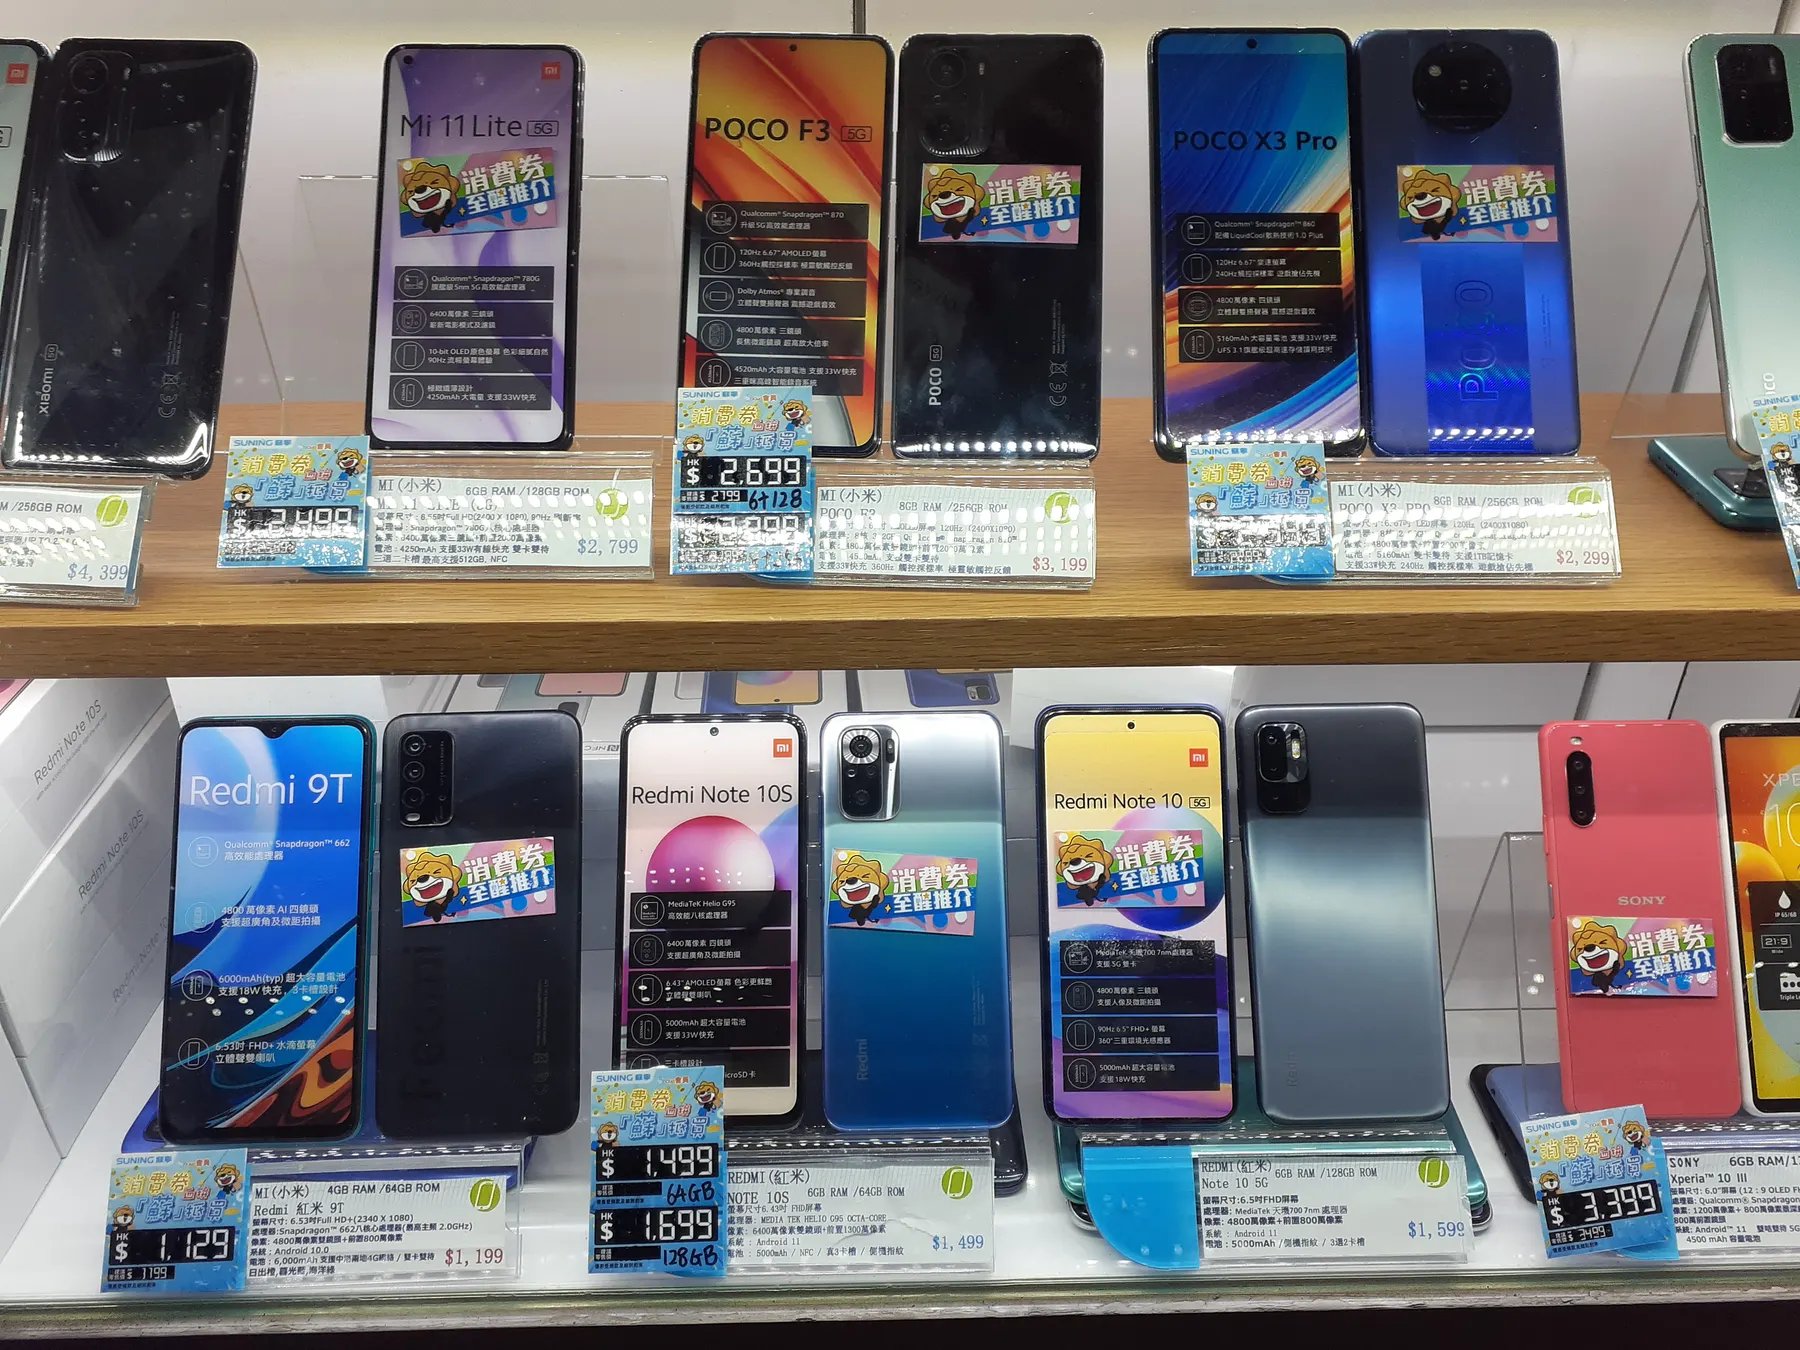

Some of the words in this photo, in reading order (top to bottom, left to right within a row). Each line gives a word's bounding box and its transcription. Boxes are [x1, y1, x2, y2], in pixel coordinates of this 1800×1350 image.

[401, 114, 431, 136] Mi
[441, 115, 464, 136] 11
[473, 114, 522, 136] Lite
[533, 123, 553, 134] 5G
[705, 117, 789, 141] POCO
[800, 119, 830, 141] F3
[847, 128, 866, 139] 5G
[1174, 131, 1247, 150] POCO
[1255, 131, 1287, 150] X3
[1296, 131, 1337, 150] Pro
[461, 153, 545, 194] 消費券
[988, 171, 1071, 205] 消費券
[1463, 171, 1547, 205] 消費券
[465, 179, 550, 215] 至醒推介
[990, 196, 1075, 225] 至醒推介
[1467, 196, 1552, 226] 至醒推介
[738, 288, 757, 296] Dolby
[1217, 335, 1249, 343] 5160mAh
[735, 366, 767, 374] 4520mAh
[929, 367, 942, 406] POCO
[1753, 396, 1789, 407] SUNING
[692, 405, 759, 425] 消費券
[234, 439, 273, 447] SUNING
[241, 453, 314, 475] 消費券
[720, 458, 801, 485] 2,699
[1202, 463, 1271, 483] 消費券
[465, 487, 487, 496] 6GB
[491, 487, 516, 496] RAM
[748, 489, 802, 510] 6+128
[56, 504, 82, 513] ROM
[900, 502, 917, 511] 8GB
[923, 503, 941, 512] RAM
[1458, 497, 1476, 506] RAM
[513, 544, 549, 554] 雙卡雙待
[578, 539, 639, 555] $2,799
[1414, 551, 1450, 560] 雙卡雙待
[1557, 551, 1610, 566] $2,299
[68, 562, 128, 581] $4,399
[1033, 557, 1087, 572] $3,199
[34, 743, 65, 785] Redmi
[63, 720, 86, 750] Note
[190, 774, 295, 806] Redmi
[308, 773, 352, 804] 9T
[633, 786, 694, 804] Redmi
[701, 786, 750, 803] Note
[757, 785, 793, 803] 10S
[1054, 793, 1108, 810] Redmi
[1114, 793, 1156, 809] Note
[1162, 793, 1183, 809] 10
[224, 851, 284, 861] 高效能處理器
[1115, 835, 1195, 871] 消費券
[464, 843, 545, 884] 消費券
[892, 864, 969, 893] 消費券
[1119, 860, 1199, 891] 至醒推介
[467, 869, 551, 904] 至醒推介
[893, 888, 972, 913] 至醒推介
[1617, 896, 1666, 905] SONY
[290, 905, 319, 914] 四鏡頭
[1627, 924, 1706, 958] 消費券
[1632, 949, 1712, 979] 至醒推介
[286, 973, 345, 983] 超大容量電池
[700, 1019, 747, 1027] 超大容量電池
[277, 1040, 316, 1050] 水滴螢幕
[216, 1054, 275, 1064] 立體聲雙喇叭
[856, 1038, 868, 1081] Redmi
[596, 1075, 633, 1083] SUNING
[605, 1088, 673, 1111] 消費券
[1526, 1122, 1561, 1133] SUNING
[1540, 1134, 1603, 1160] 消費券
[116, 1157, 154, 1165] SUNING
[646, 1145, 713, 1176] 1,499
[1669, 1157, 1700, 1168] SONY
[1730, 1157, 1754, 1167] 6GB
[1275, 1168, 1293, 1178] 6GB
[1297, 1167, 1316, 1178] RAM
[1360, 1167, 1378, 1177] ROM
[1718, 1173, 1731, 1183] 10
[123, 1171, 192, 1195] 消費券
[327, 1185, 349, 1195] 4GB
[352, 1184, 376, 1194] RAM
[416, 1183, 441, 1193] ROM
[1202, 1178, 1229, 1189] Note
[1235, 1178, 1249, 1189] 10
[1255, 1177, 1268, 1188] 5G
[666, 1181, 715, 1205] 64GB
[728, 1192, 759, 1204] NOTE
[767, 1191, 789, 1203] 10S
[808, 1187, 825, 1197] 6GB
[830, 1187, 848, 1197] RAM
[887, 1186, 905, 1197] ROM
[254, 1204, 289, 1216] Redmi
[296, 1202, 323, 1216] 紅米
[330, 1202, 344, 1214] 9T
[1235, 1206, 1271, 1215] MediaTek
[1322, 1206, 1348, 1215] 處理器
[1581, 1183, 1656, 1222] 3,399
[645, 1209, 713, 1241] 1,699
[1408, 1221, 1465, 1238] $1,599
[756, 1238, 788, 1246] Android
[1234, 1230, 1265, 1238] Android
[1730, 1235, 1761, 1243] 容量電池
[160, 1229, 229, 1262] 1,129
[275, 1246, 308, 1255] Android
[933, 1235, 984, 1250] $1,499
[1231, 1239, 1276, 1249] 5000mAh
[403, 1253, 435, 1262] 雙卡雙待
[445, 1248, 503, 1267] $1,199
[664, 1246, 718, 1266] 128GB
